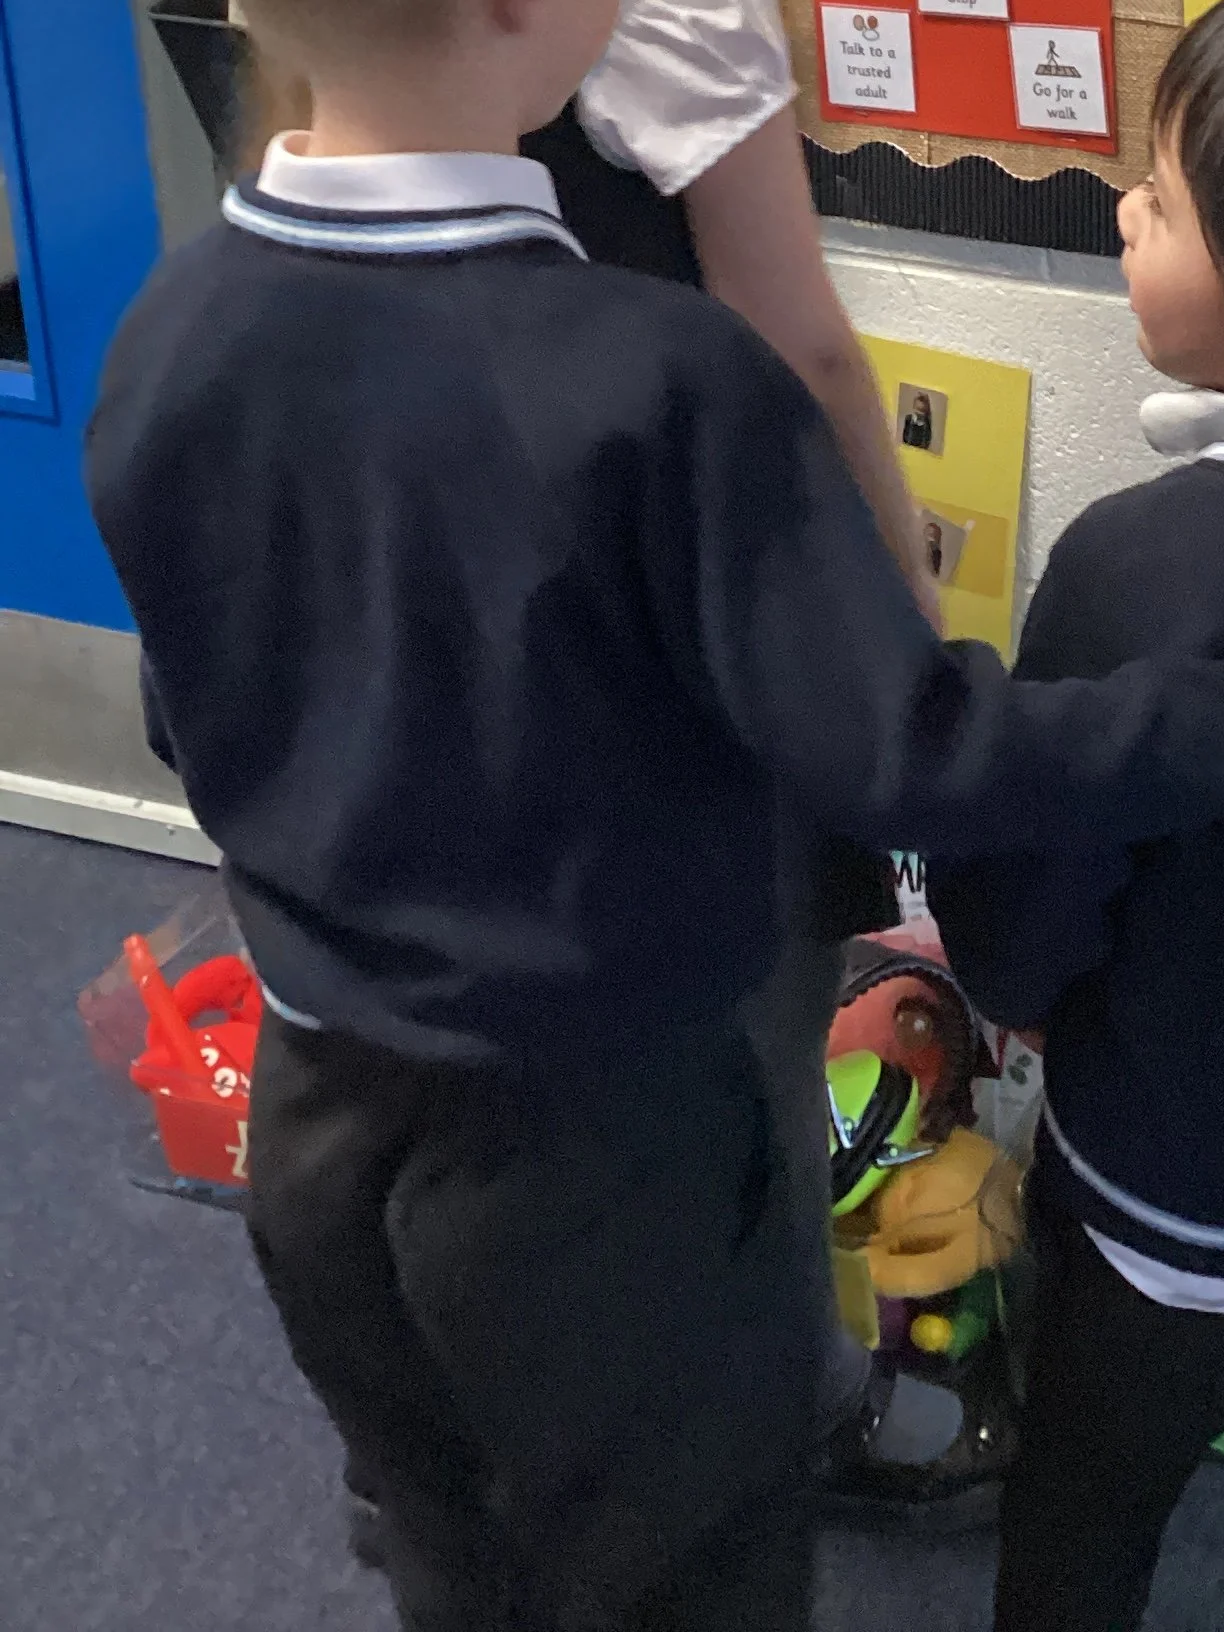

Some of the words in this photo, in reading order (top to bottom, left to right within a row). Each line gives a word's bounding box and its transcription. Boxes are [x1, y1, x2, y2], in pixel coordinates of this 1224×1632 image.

[840, 40, 866, 56] Talk
[869, 45, 884, 59] to
[887, 49, 896, 59] a
[847, 64, 892, 80] trusted
[855, 84, 888, 101] adult
[1032, 82, 1052, 99] Go
[1055, 83, 1076, 102] for
[1079, 90, 1087, 101] a
[1046, 105, 1077, 121] walk
